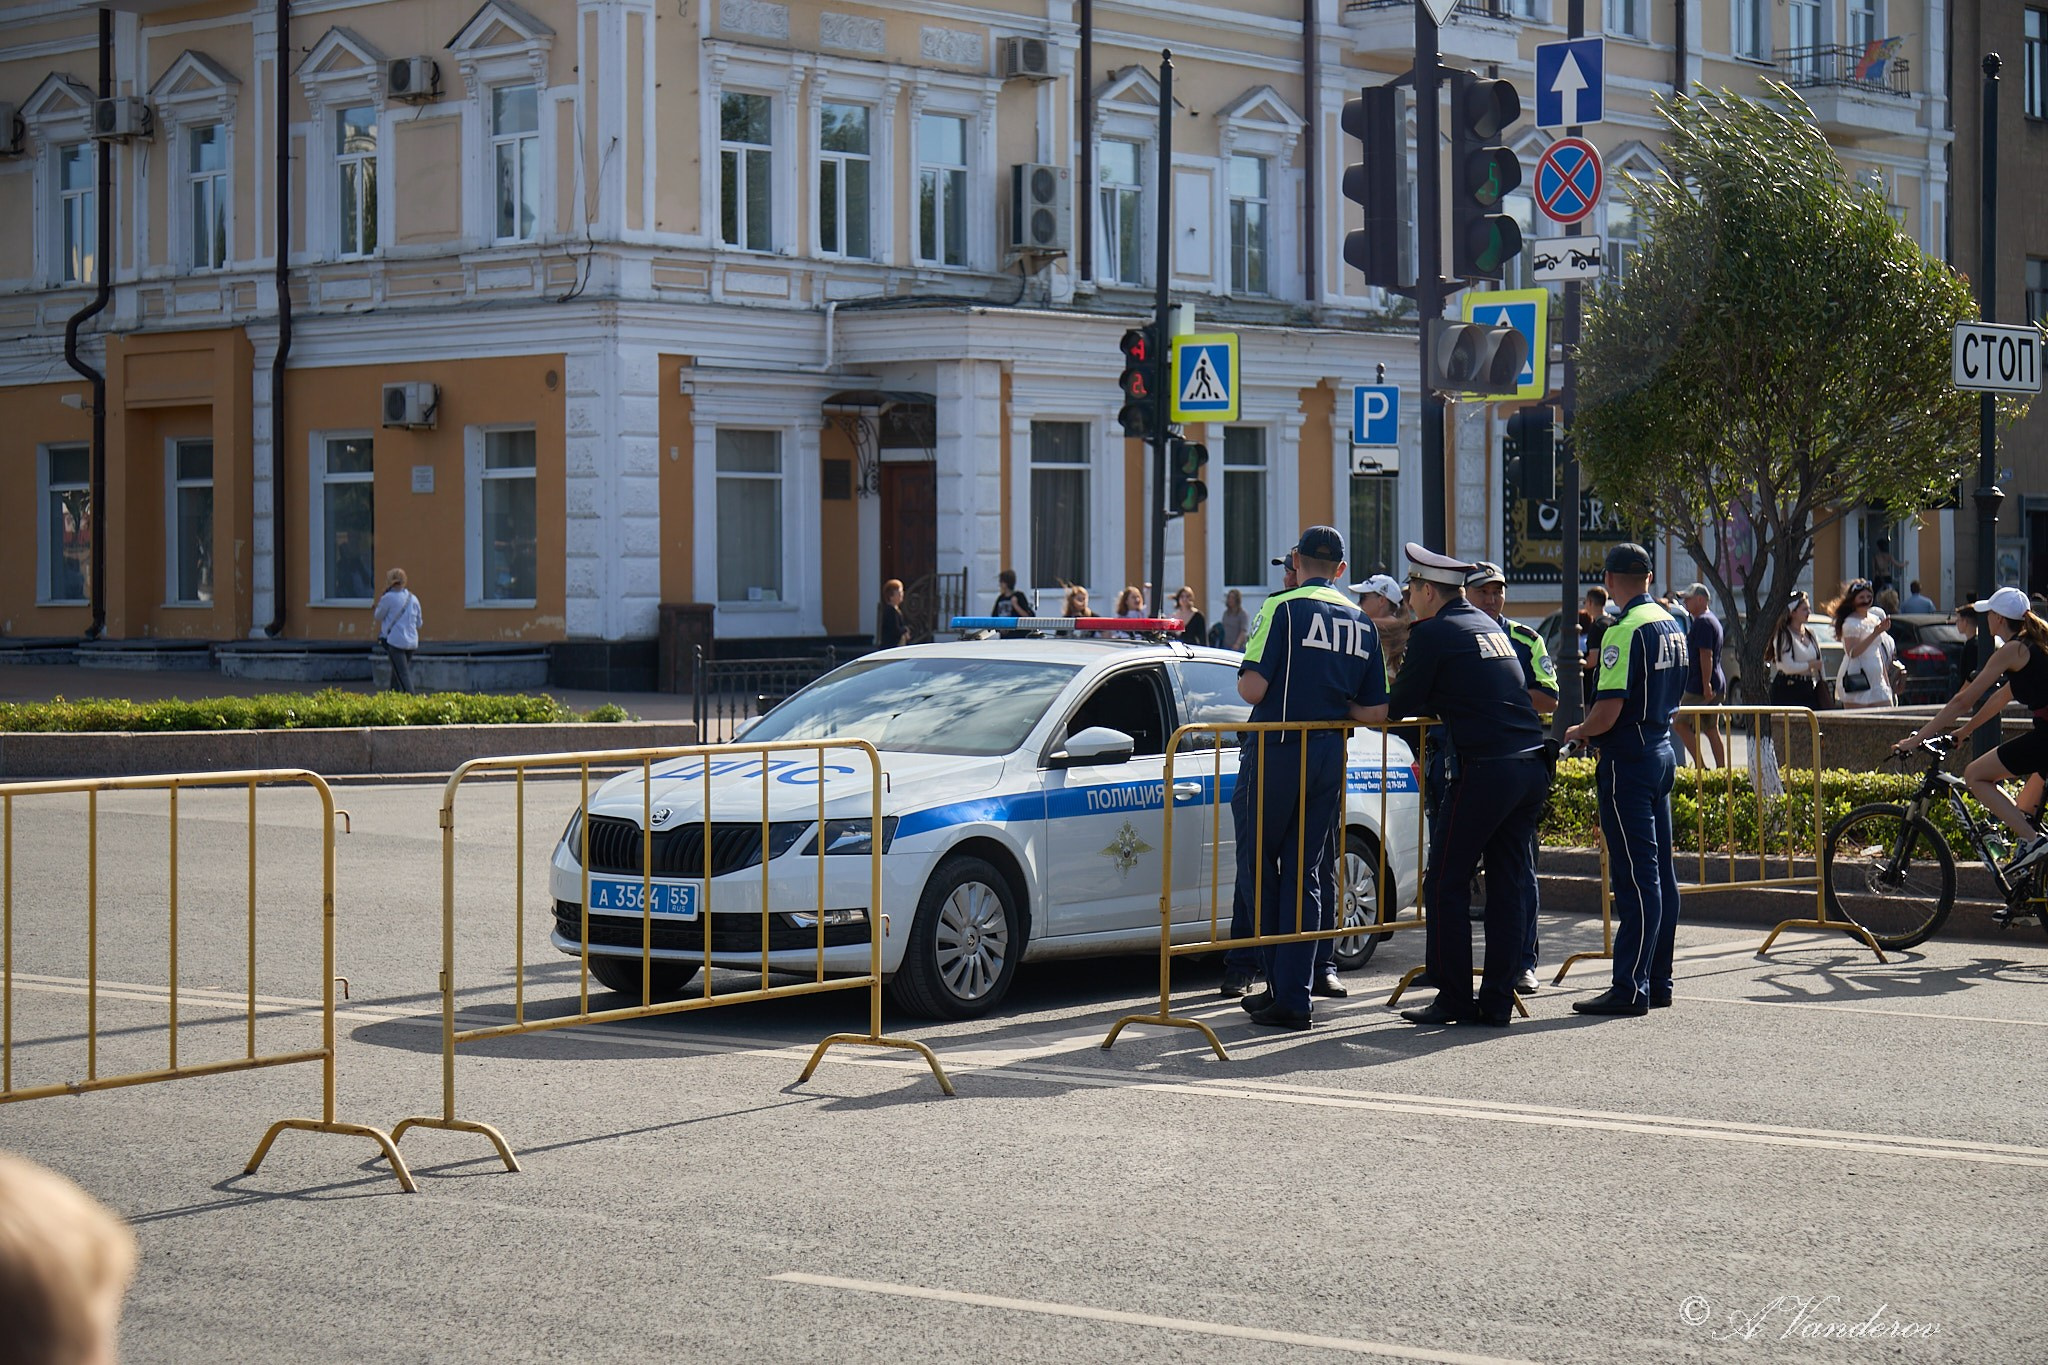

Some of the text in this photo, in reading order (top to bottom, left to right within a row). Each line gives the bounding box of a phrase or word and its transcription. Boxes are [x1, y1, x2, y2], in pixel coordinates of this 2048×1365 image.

[1963, 333, 2034, 383] СТОП
[1363, 391, 1389, 439] P
[1538, 499, 1622, 531] OERA
[1302, 612, 1371, 660] ДПС
[636, 760, 856, 785] ДПС
[1086, 784, 1166, 810] ПОЛИЦИЯ
[670, 887, 689, 905] 55
[671, 903, 686, 912] RUS
